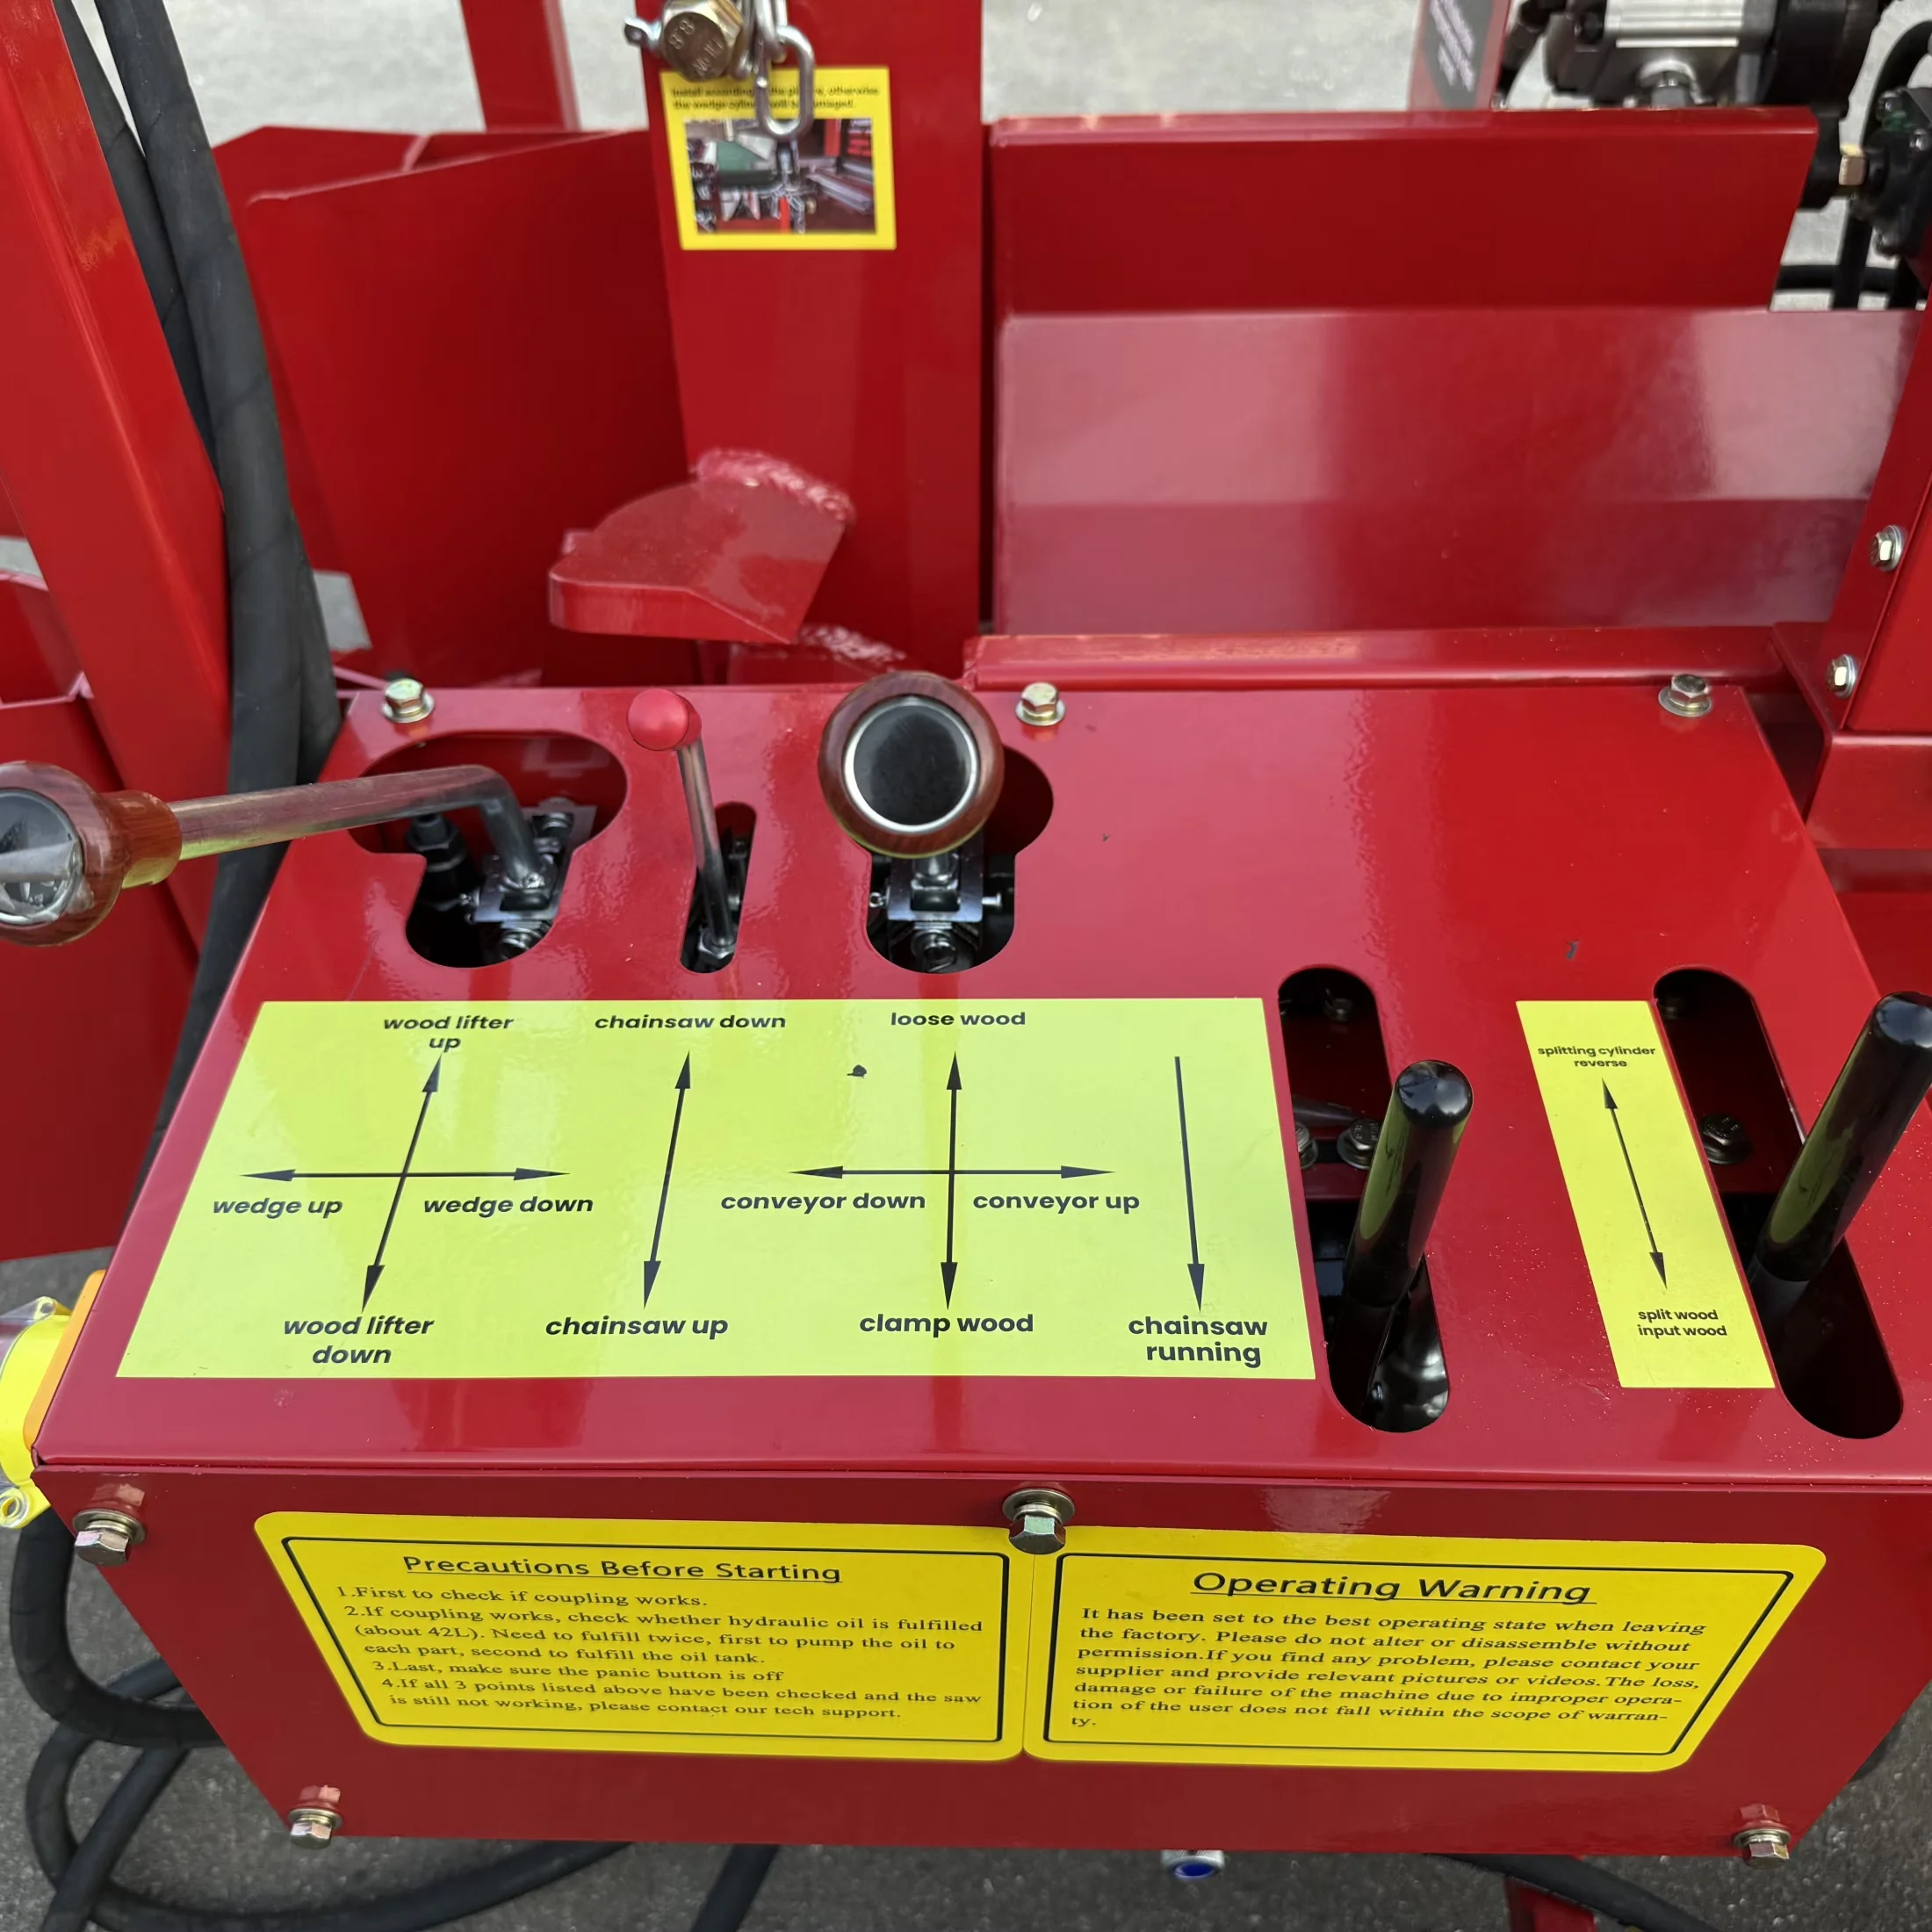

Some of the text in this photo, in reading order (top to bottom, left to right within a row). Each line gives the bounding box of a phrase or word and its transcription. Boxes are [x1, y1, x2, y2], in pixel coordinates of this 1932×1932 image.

[385, 1015, 514, 1029] wood lifter
[595, 1014, 785, 1028] chainsaw down
[891, 1013, 1025, 1025] loose wood
[429, 1038, 460, 1052] up
[1538, 1047, 1655, 1056] splitting cylinder
[213, 1198, 342, 1219] wedge up
[425, 1196, 593, 1218] wedge down
[721, 1193, 925, 1214] conveyor down
[973, 1196, 1139, 1214] conveyor up
[285, 1316, 435, 1334] wood lifter
[860, 1314, 1033, 1337] clamp wood
[1128, 1316, 1267, 1335] chainsaw
[1639, 1308, 1719, 1322] split wood
[546, 1316, 728, 1339] chainsaw up
[1638, 1324, 1727, 1337] input wood
[313, 1345, 391, 1363] down
[1147, 1342, 1260, 1368] running
[402, 1556, 841, 1583] Precautions Before Starting
[411, 1590, 433, 1598] to
[440, 1589, 503, 1600] check
[509, 1590, 527, 1601] if
[534, 1592, 629, 1606] coupling
[635, 1594, 706, 1605] works.
[1193, 1572, 1590, 1604] Operating Warning
[390, 1608, 483, 1621] coupling
[489, 1611, 560, 1623] works,
[567, 1611, 629, 1623] check
[636, 1613, 721, 1625] whether
[728, 1615, 828, 1628] hydraulic
[836, 1618, 863, 1628] oil
[872, 1618, 889, 1628] is
[898, 1618, 982, 1631] fulfilled
[1082, 1607, 1706, 1635] It has been set to the best operating state when leaving
[355, 1624, 422, 1636] (about
[490, 1628, 546, 1639] Need
[580, 1630, 639, 1641] fulfill
[648, 1633, 710, 1645] twice,
[718, 1633, 761, 1644] first
[768, 1636, 788, 1645] to
[796, 1638, 854, 1649] pump
[861, 1637, 892, 1647] the
[900, 1638, 926, 1648] oil
[1080, 1626, 1113, 1638] the
[1121, 1628, 1205, 1643] factory.
[1215, 1631, 1287, 1643] Please
[1294, 1633, 1322, 1644] do
[1329, 1636, 1366, 1645] not
[1372, 1635, 1424, 1646] alter
[1460, 1637, 1597, 1649] disassemble
[1605, 1640, 1690, 1651] without
[364, 1643, 764, 1662] each part, second to fulfill the oil tank.
[1230, 1653, 1271, 1662] you
[1280, 1651, 1324, 1662] find
[1331, 1655, 1371, 1666] any
[1376, 1654, 1474, 1668] problem,
[1482, 1656, 1554, 1669] please
[1561, 1659, 1641, 1669] contact
[1645, 1662, 1699, 1671] your
[1076, 1665, 1164, 1677] supplier
[1171, 1667, 1208, 1677] and
[1215, 1669, 1299, 1680] provide
[1306, 1670, 1395, 1682] relevant
[1400, 1672, 1488, 1684] pictures
[1651, 1676, 1698, 1689] loss,
[423, 1679, 448, 1689] all
[455, 1680, 466, 1689] 3
[474, 1681, 535, 1692] points
[541, 1682, 595, 1692] listed
[603, 1684, 661, 1694] above
[668, 1686, 715, 1696] have
[722, 1687, 768, 1698] been
[775, 1689, 856, 1699] checked
[864, 1691, 898, 1700] and
[907, 1692, 936, 1701] the
[1074, 1682, 1156, 1695] damage
[1193, 1684, 1263, 1696] failure
[1270, 1687, 1296, 1697] of
[1300, 1688, 1331, 1698] the
[1338, 1689, 1429, 1699] machine
[1436, 1690, 1474, 1700] due
[1481, 1692, 1502, 1701] to
[1510, 1691, 1608, 1705] improper
[1613, 1696, 1681, 1705] opera-
[1073, 1699, 1112, 1709] tion
[1120, 1700, 1145, 1710] of
[1150, 1700, 1180, 1711] the
[1239, 1703, 1286, 1713] does
[1336, 1705, 1370, 1715] fall
[1379, 1706, 1444, 1717] within
[1453, 1707, 1484, 1717] the
[1490, 1711, 1550, 1720] scope
[1557, 1710, 1584, 1719] of
[1071, 1717, 1095, 1727] ty.
